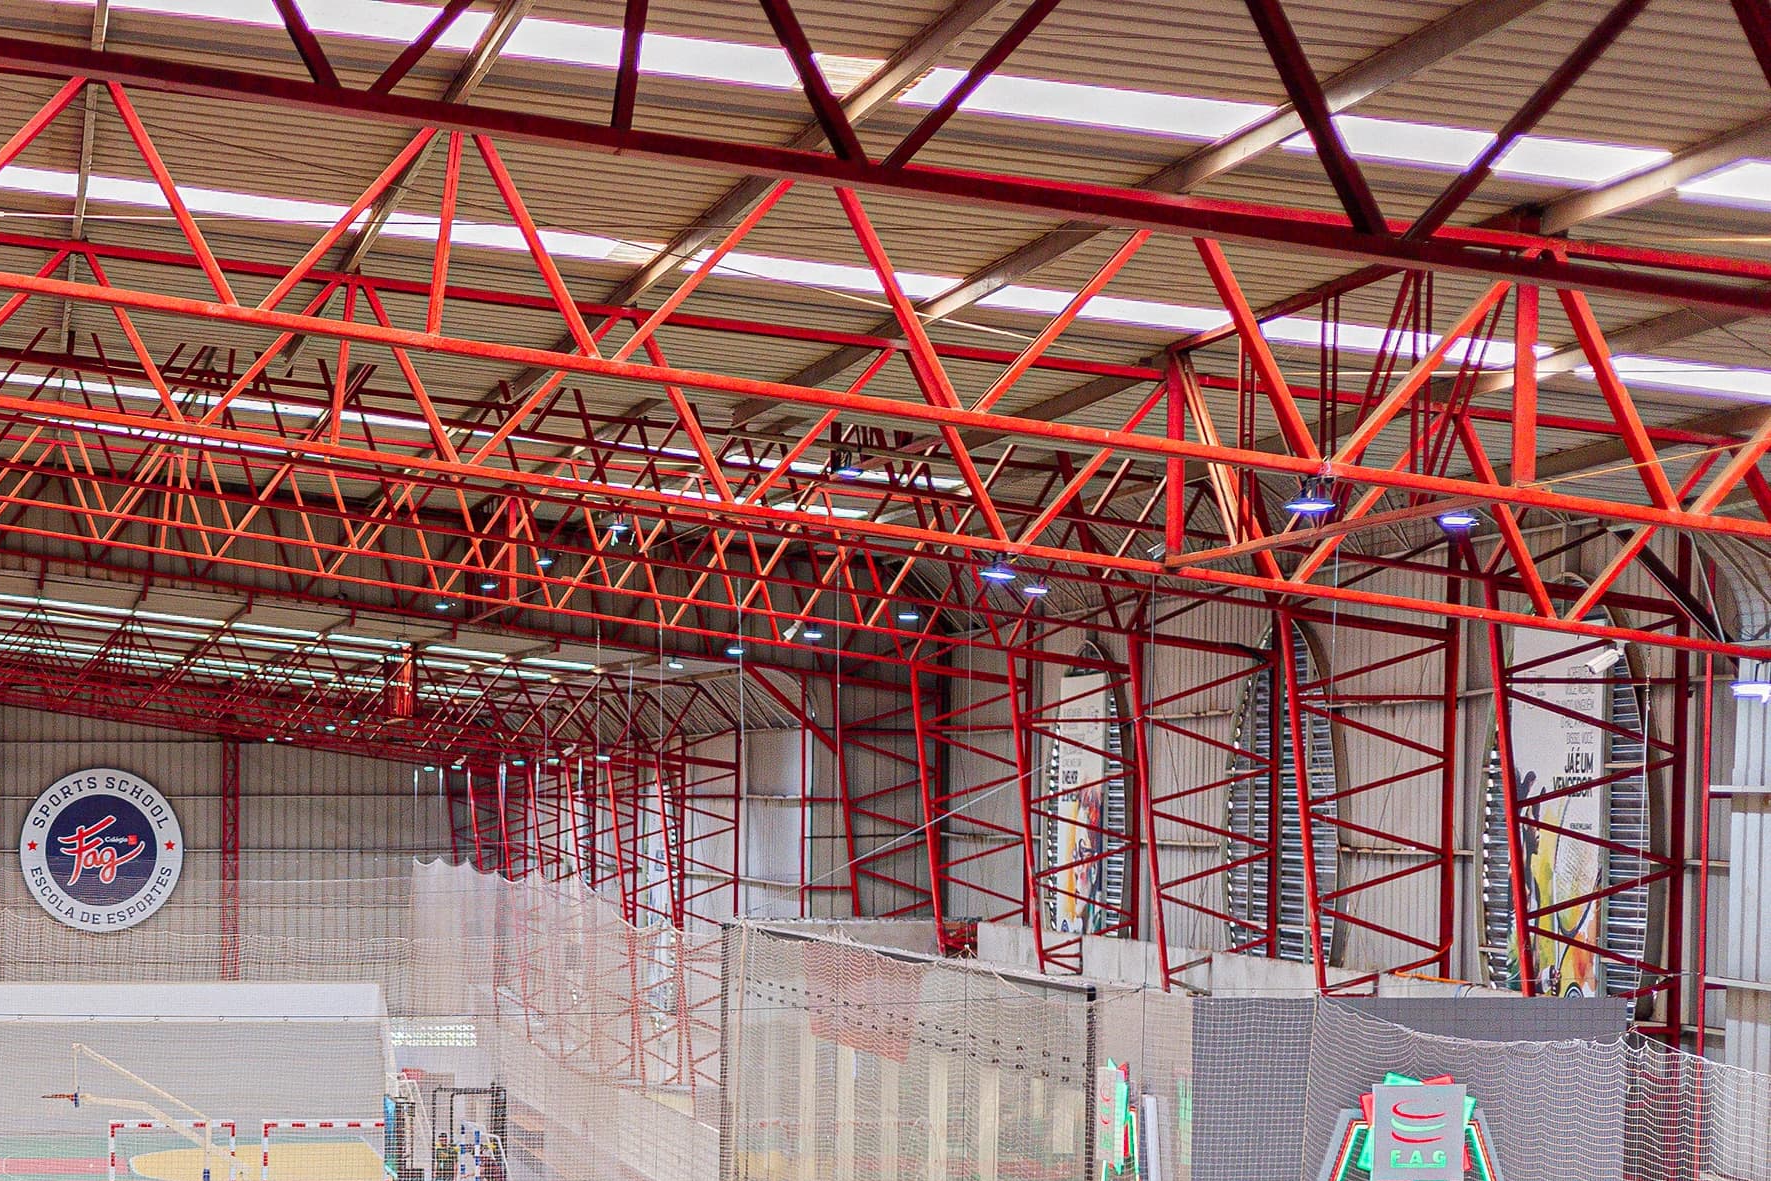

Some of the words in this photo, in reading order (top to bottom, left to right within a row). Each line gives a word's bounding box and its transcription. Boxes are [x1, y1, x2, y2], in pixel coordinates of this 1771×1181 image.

[1581, 752, 1594, 774] UM
[32, 777, 97, 829] SPORTS
[105, 777, 170, 829] SCHOOL
[30, 866, 74, 919] ESCOLA
[79, 911, 101, 925] DE
[107, 866, 173, 925] ESPORTES
[1389, 1150, 1447, 1168] FAG
